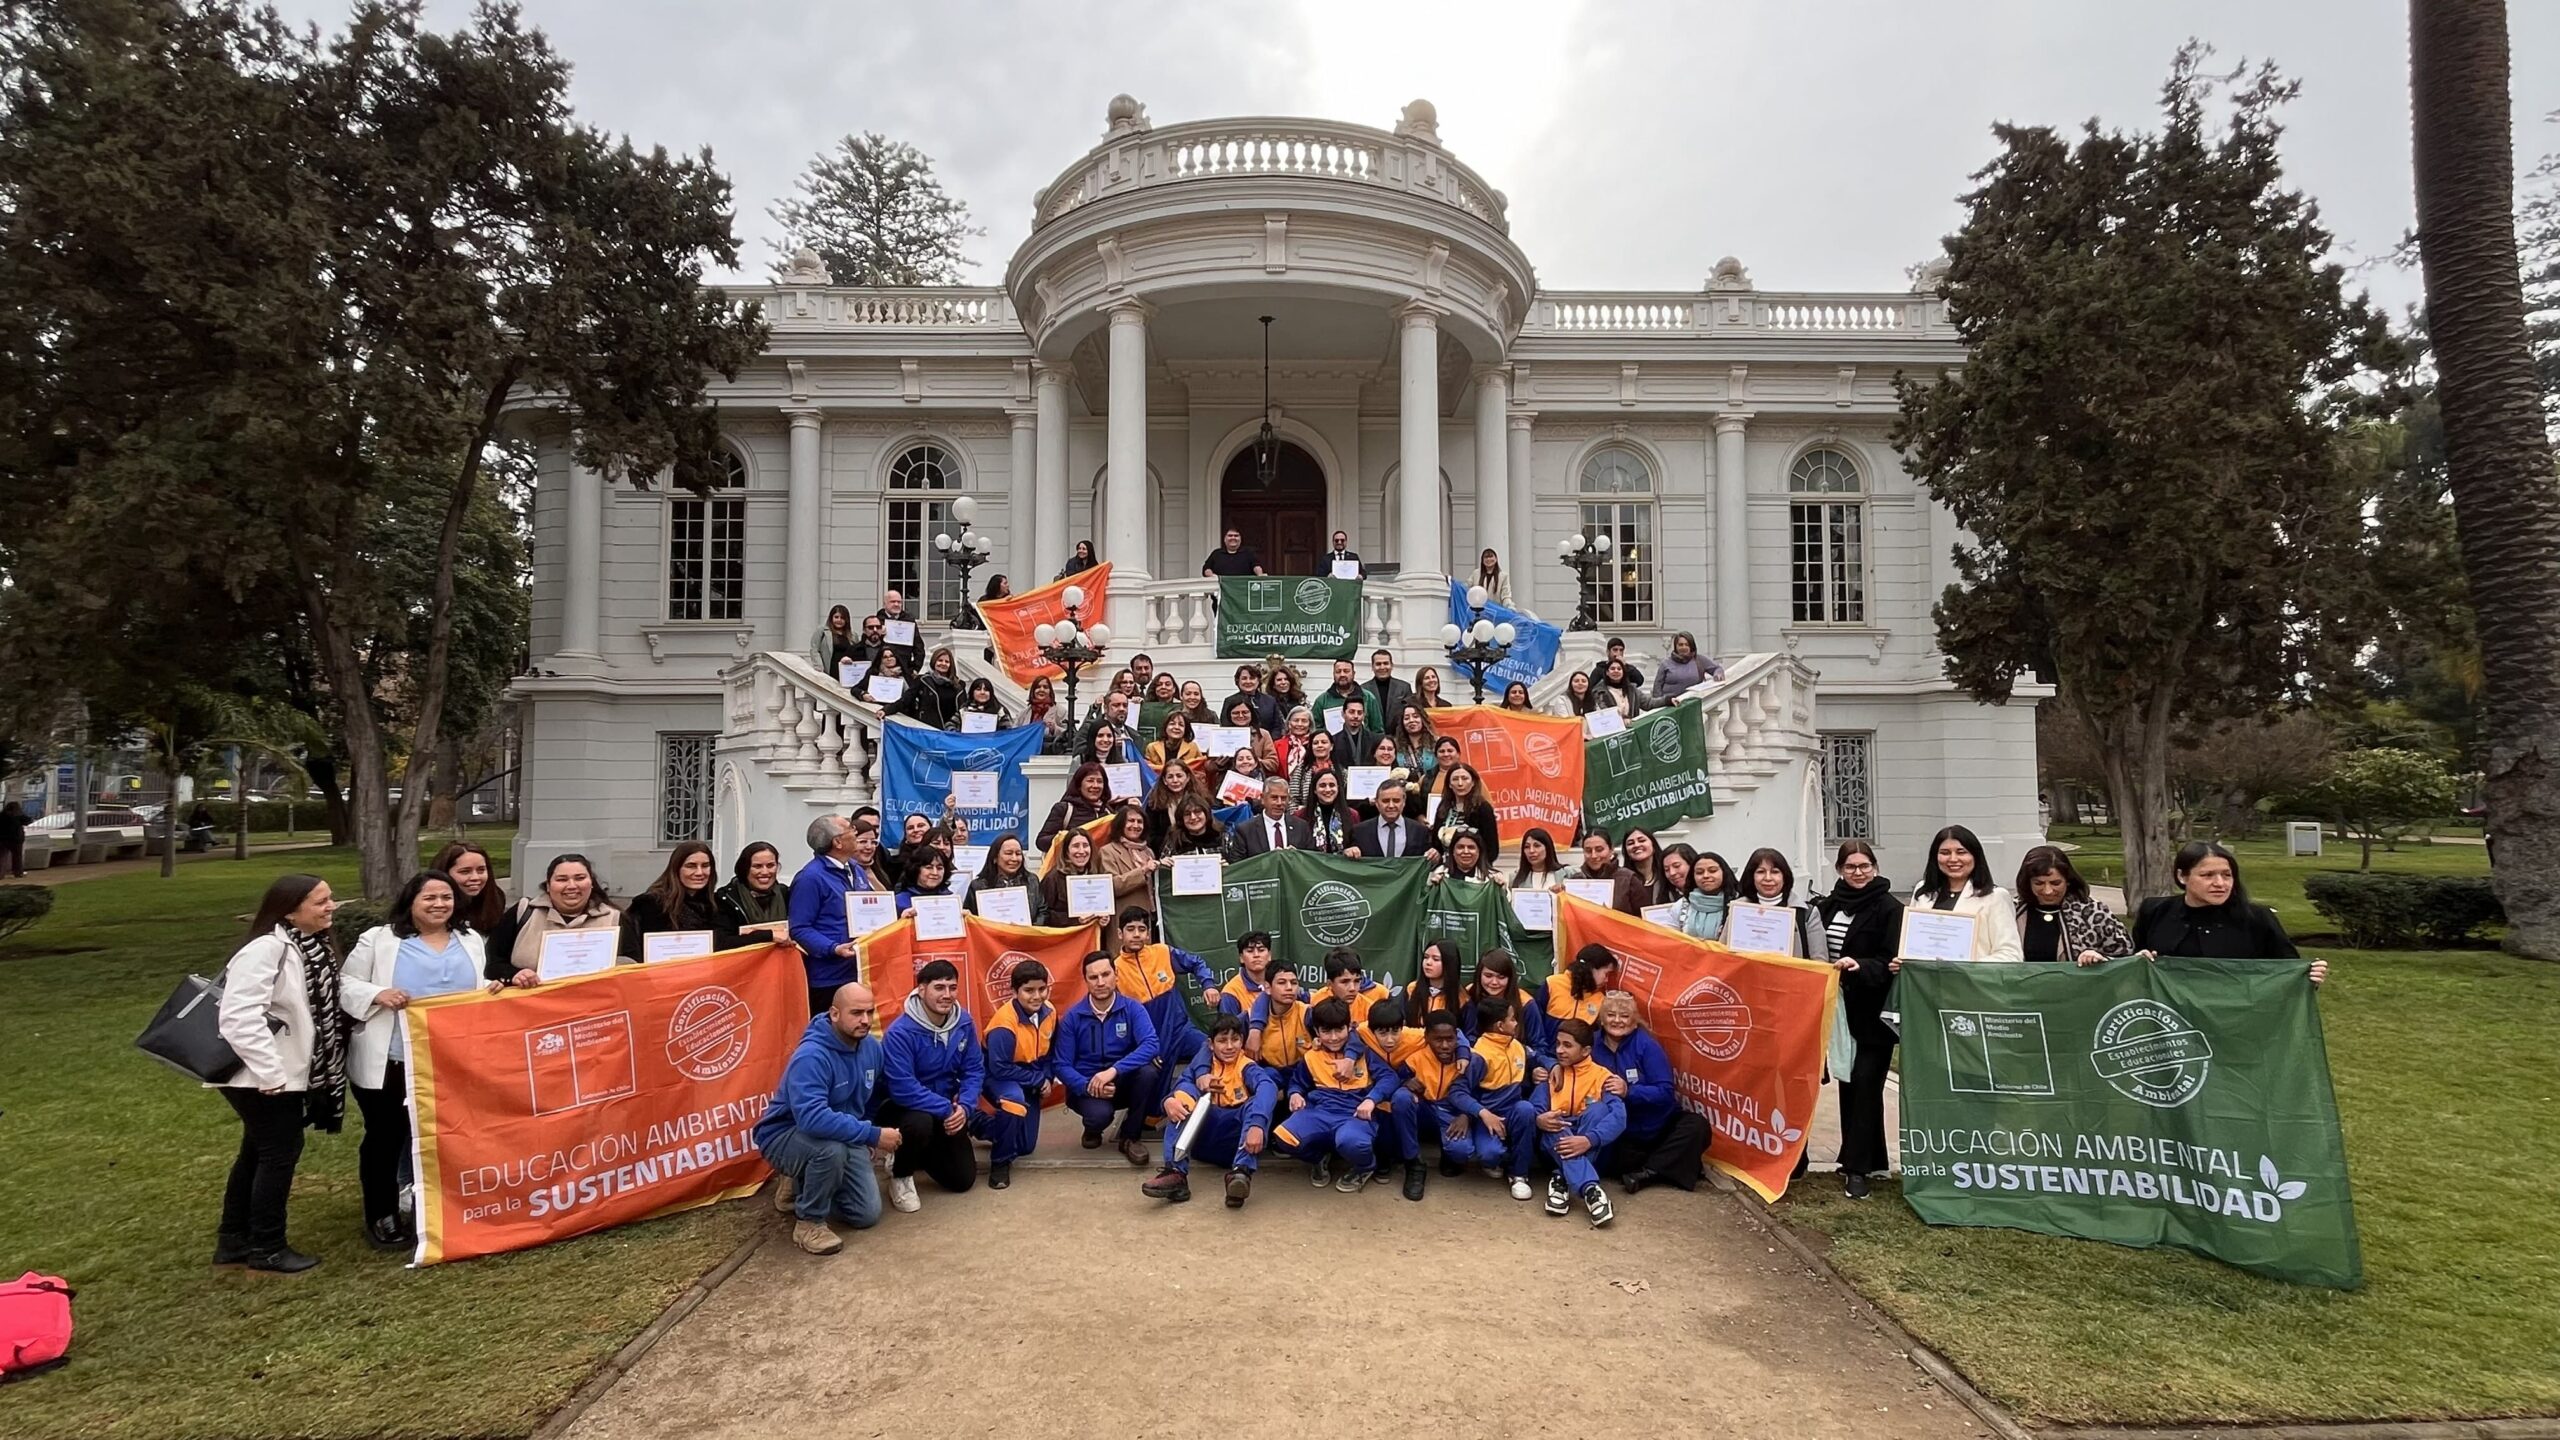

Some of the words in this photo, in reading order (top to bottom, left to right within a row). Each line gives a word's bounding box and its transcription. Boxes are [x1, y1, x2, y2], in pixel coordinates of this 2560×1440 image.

[1226, 623, 1281, 634] EDUCACIÓN
[1284, 623, 1337, 634] AMBIENTAL
[1244, 634, 1344, 646] SUSTENTABILIDAD
[1500, 657, 1535, 674] BIENTAL
[2102, 1007, 2180, 1044] Certificación
[692, 1041, 744, 1074] Ambiental
[1672, 1067, 1766, 1125] MBIENTAL
[1675, 1091, 1784, 1156] ABILIDAD
[460, 1130, 637, 1197] EDUCACIÓN
[463, 1203, 501, 1224] para
[505, 1196, 522, 1212] la
[528, 1127, 760, 1218] SUSTENTABILI
[1899, 1127, 2064, 1158] EDUCACIÓN
[2074, 1134, 2254, 1181] AMBIENTAL
[1931, 1163, 1947, 1177] la
[1951, 1161, 2283, 1223] SUSTENTABILIDAD
